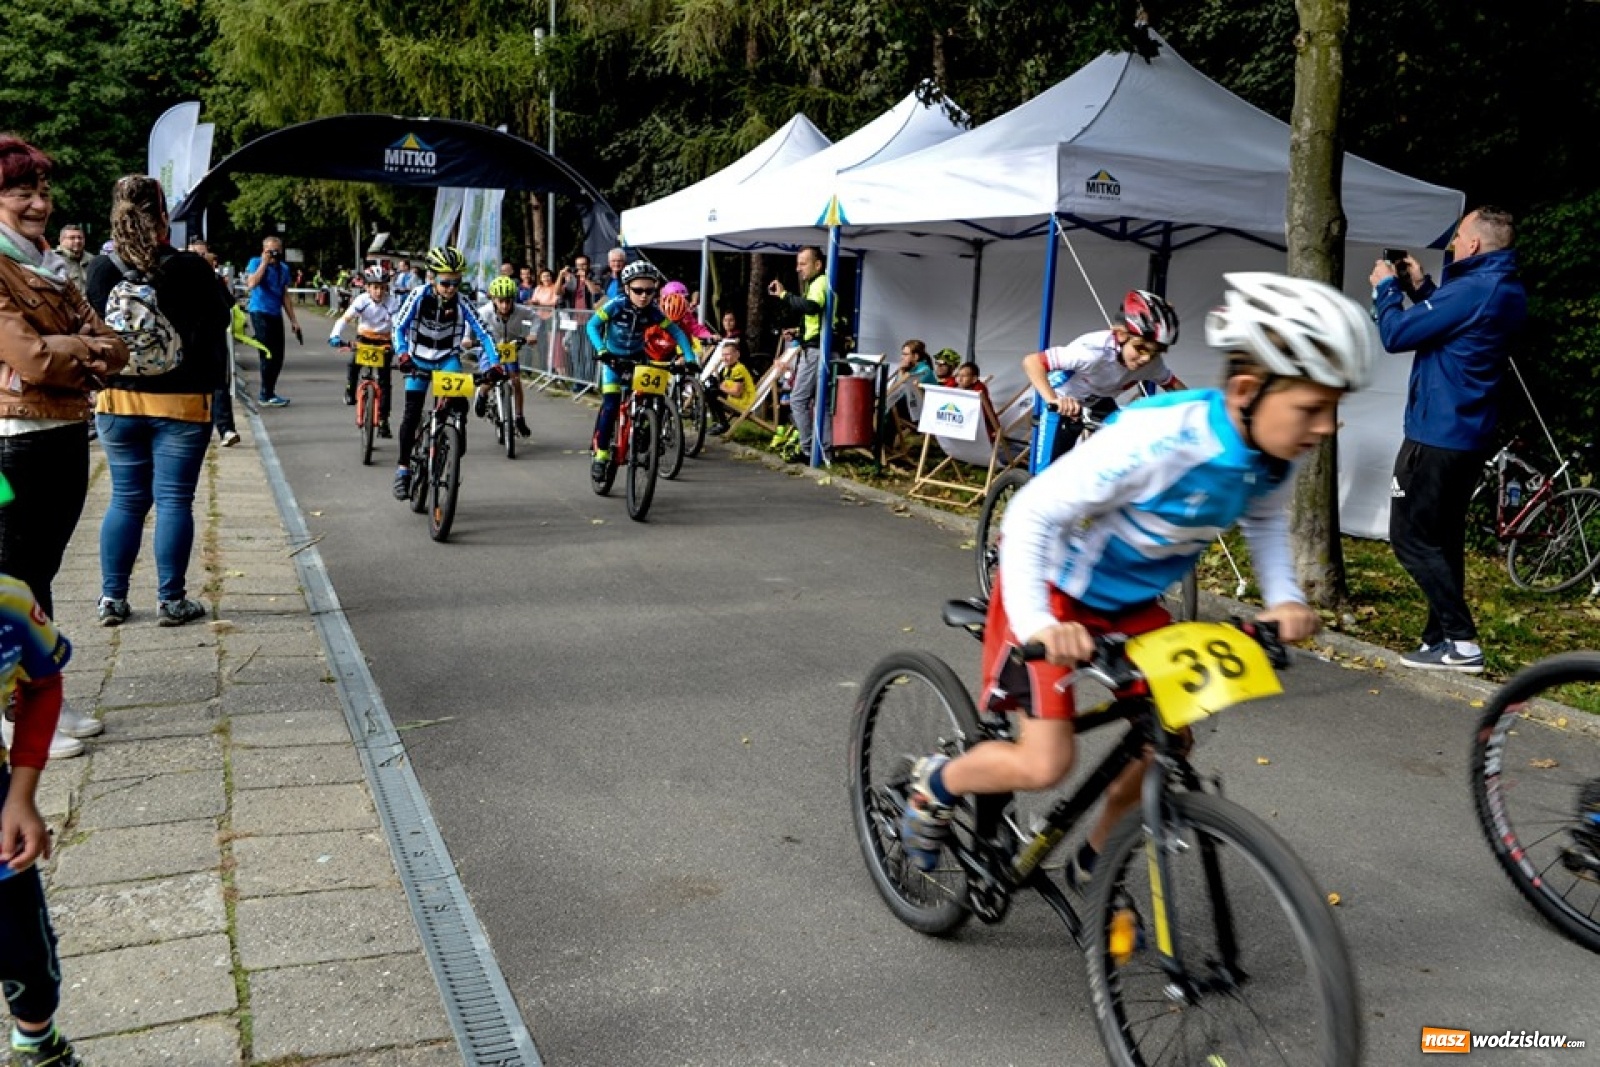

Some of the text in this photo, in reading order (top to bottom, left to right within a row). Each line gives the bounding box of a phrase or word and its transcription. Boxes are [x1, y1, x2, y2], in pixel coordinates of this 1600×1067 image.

[384, 149, 437, 168] MITKO
[1086, 181, 1120, 196] MITKO
[441, 376, 465, 391] 37
[640, 373, 661, 388] 34
[936, 411, 964, 424] MITKO
[1170, 639, 1246, 694] 38
